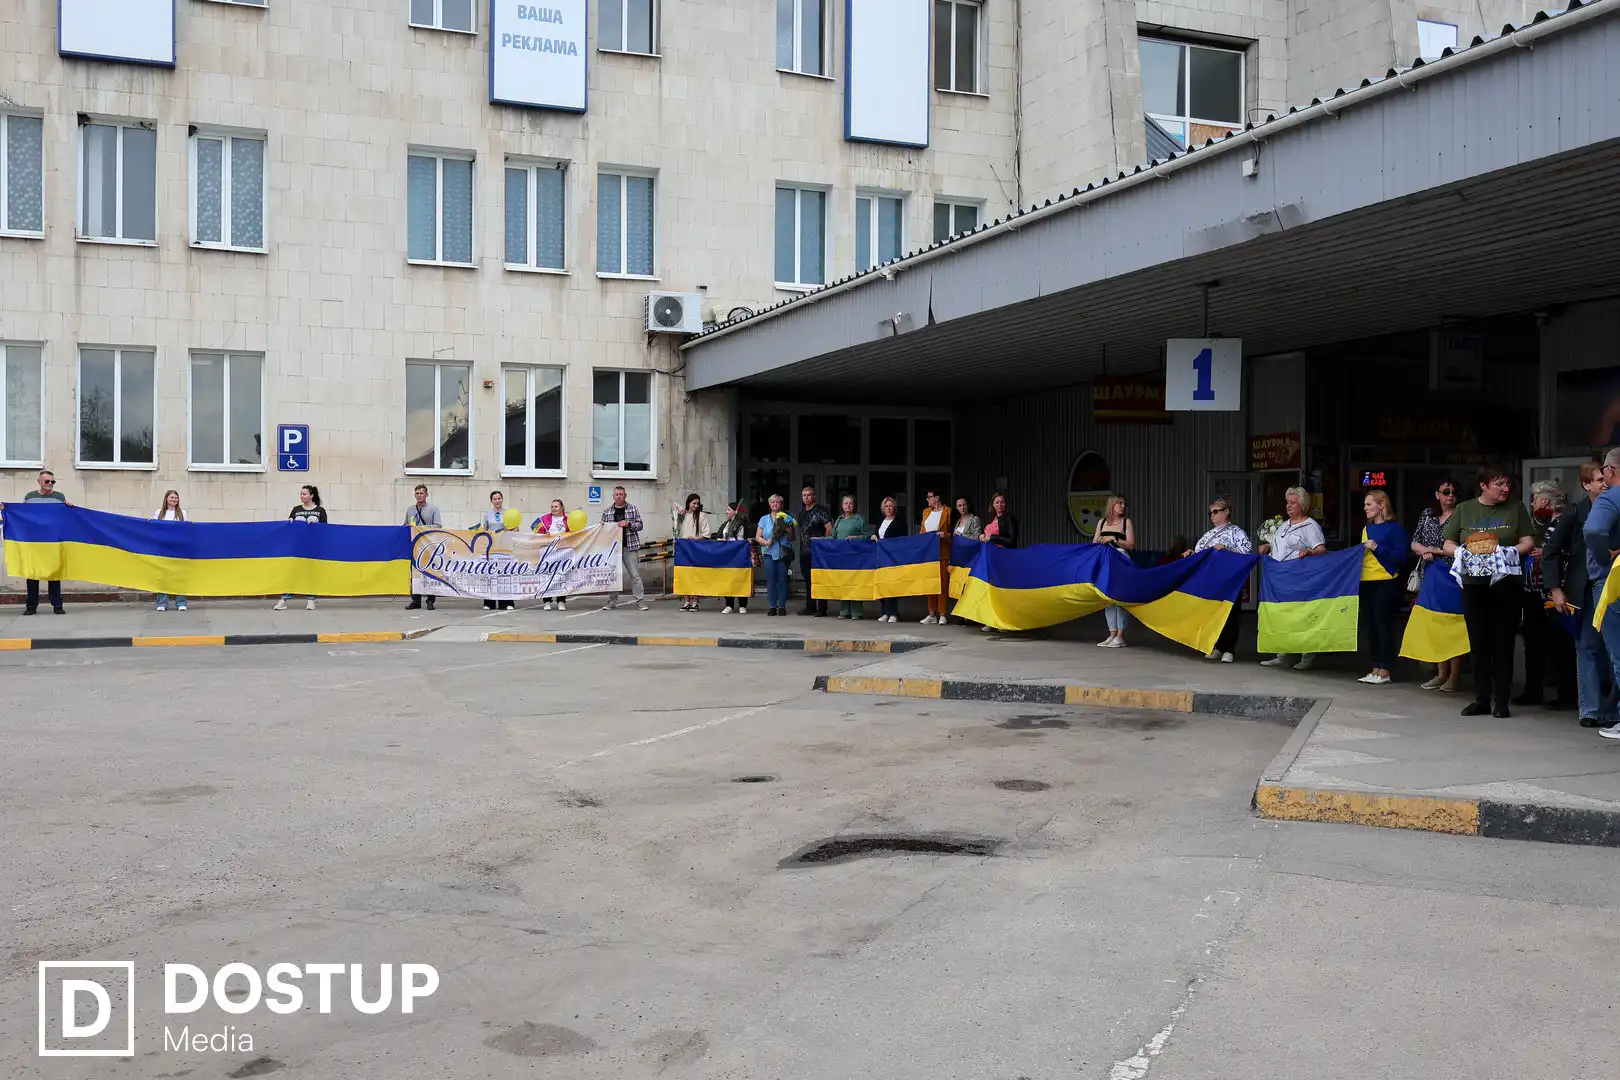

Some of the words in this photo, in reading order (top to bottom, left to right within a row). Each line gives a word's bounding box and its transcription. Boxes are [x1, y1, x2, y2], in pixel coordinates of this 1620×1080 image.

[517, 4, 563, 25] ВАША
[501, 32, 578, 56] РЕКЛАМА
[1192, 347, 1215, 401] 1
[1093, 383, 1166, 401] ШАУРМ
[283, 429, 303, 453] P
[1370, 479, 1387, 487] КАВА
[1371, 472, 1385, 480] ЧАЙ
[417, 538, 529, 574] Вітаємо
